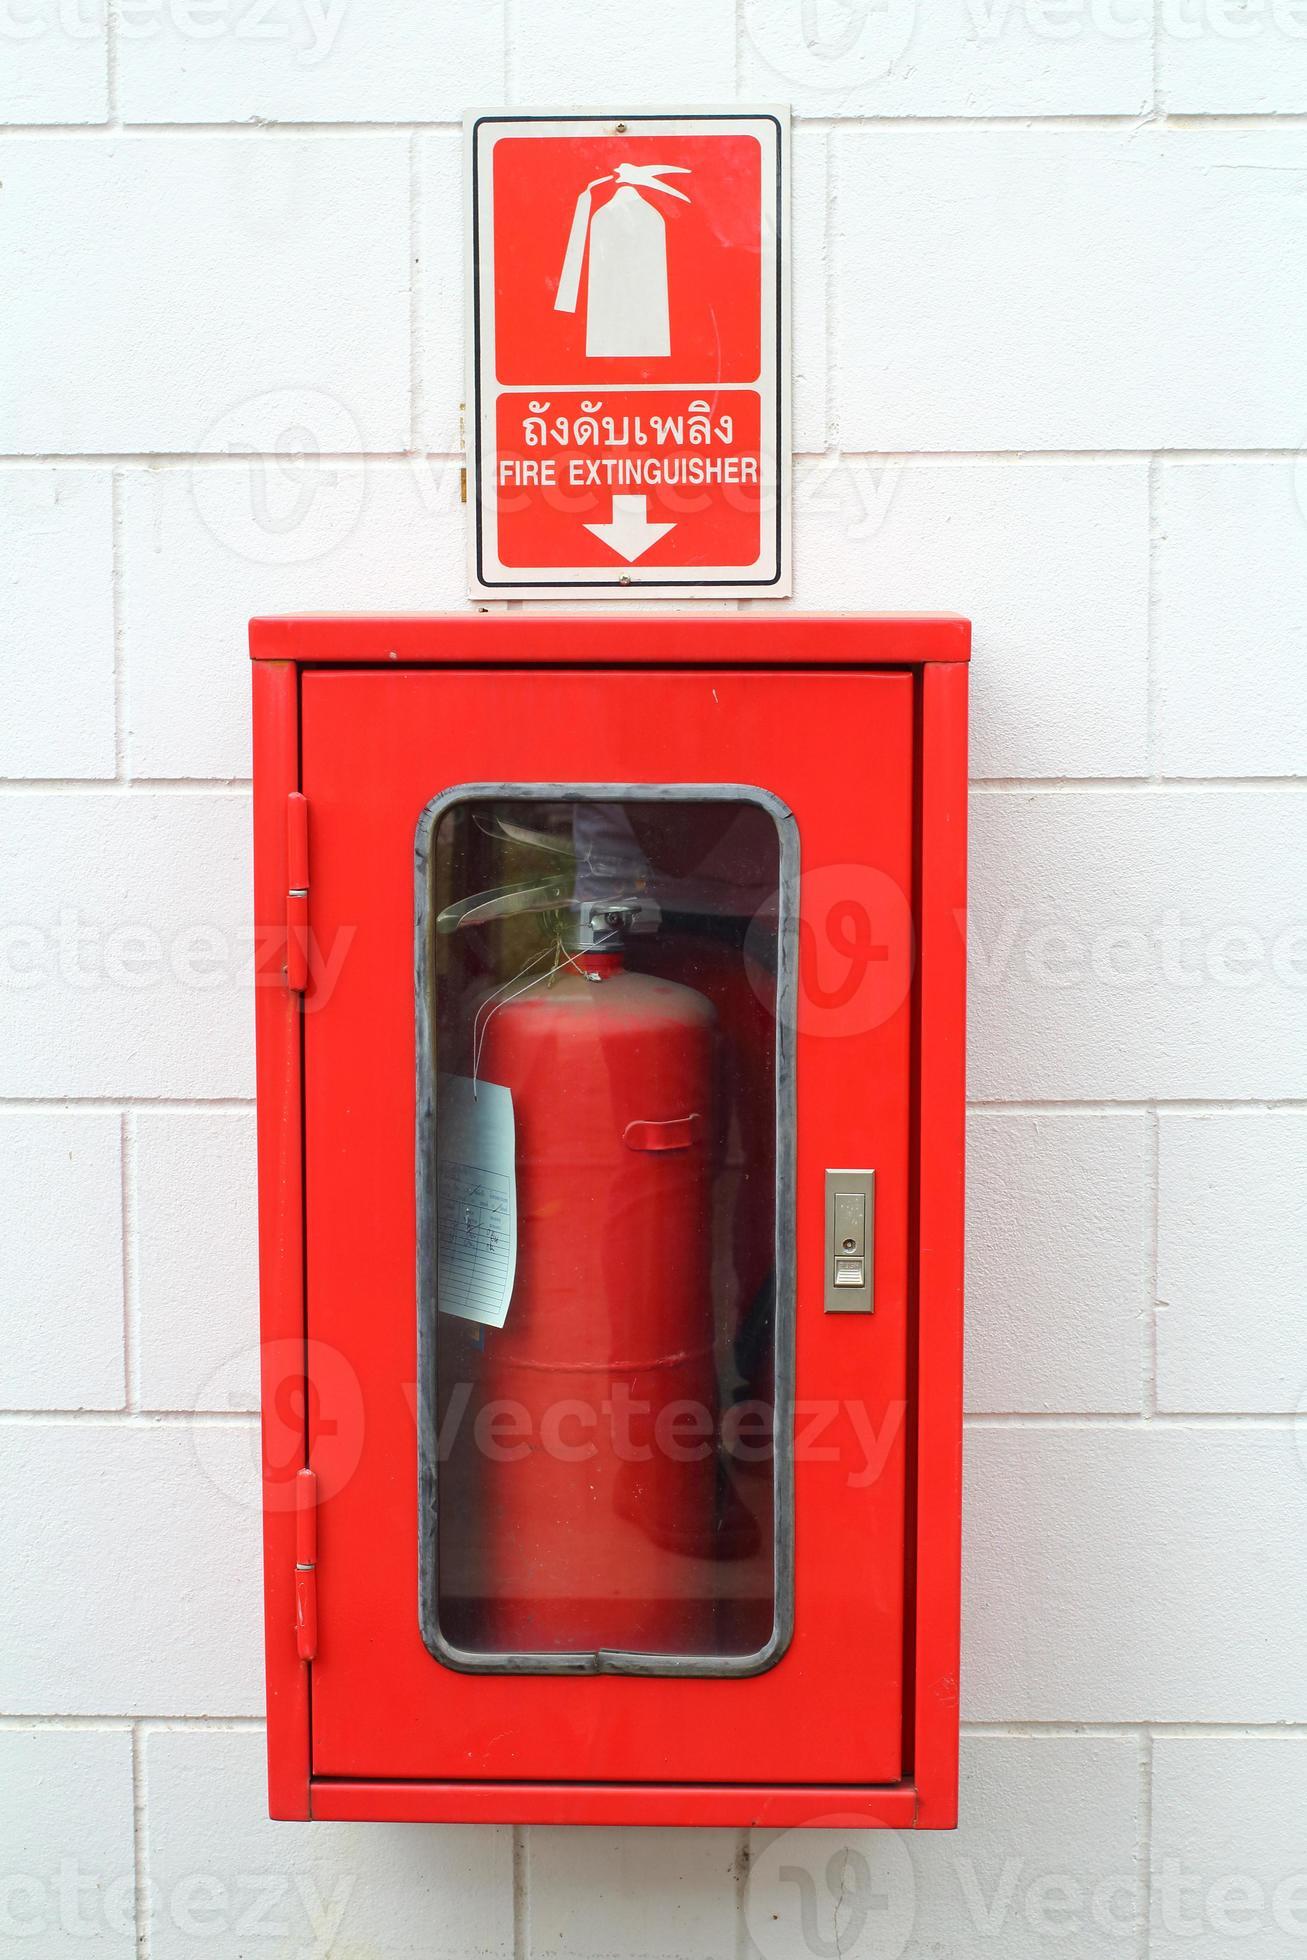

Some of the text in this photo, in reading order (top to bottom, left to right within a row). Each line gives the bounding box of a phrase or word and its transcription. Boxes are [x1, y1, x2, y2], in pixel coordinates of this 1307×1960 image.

[521, 400, 733, 446] ถังดับเพลิง
[500, 457, 757, 486] FIRE EXTINGUISHER
